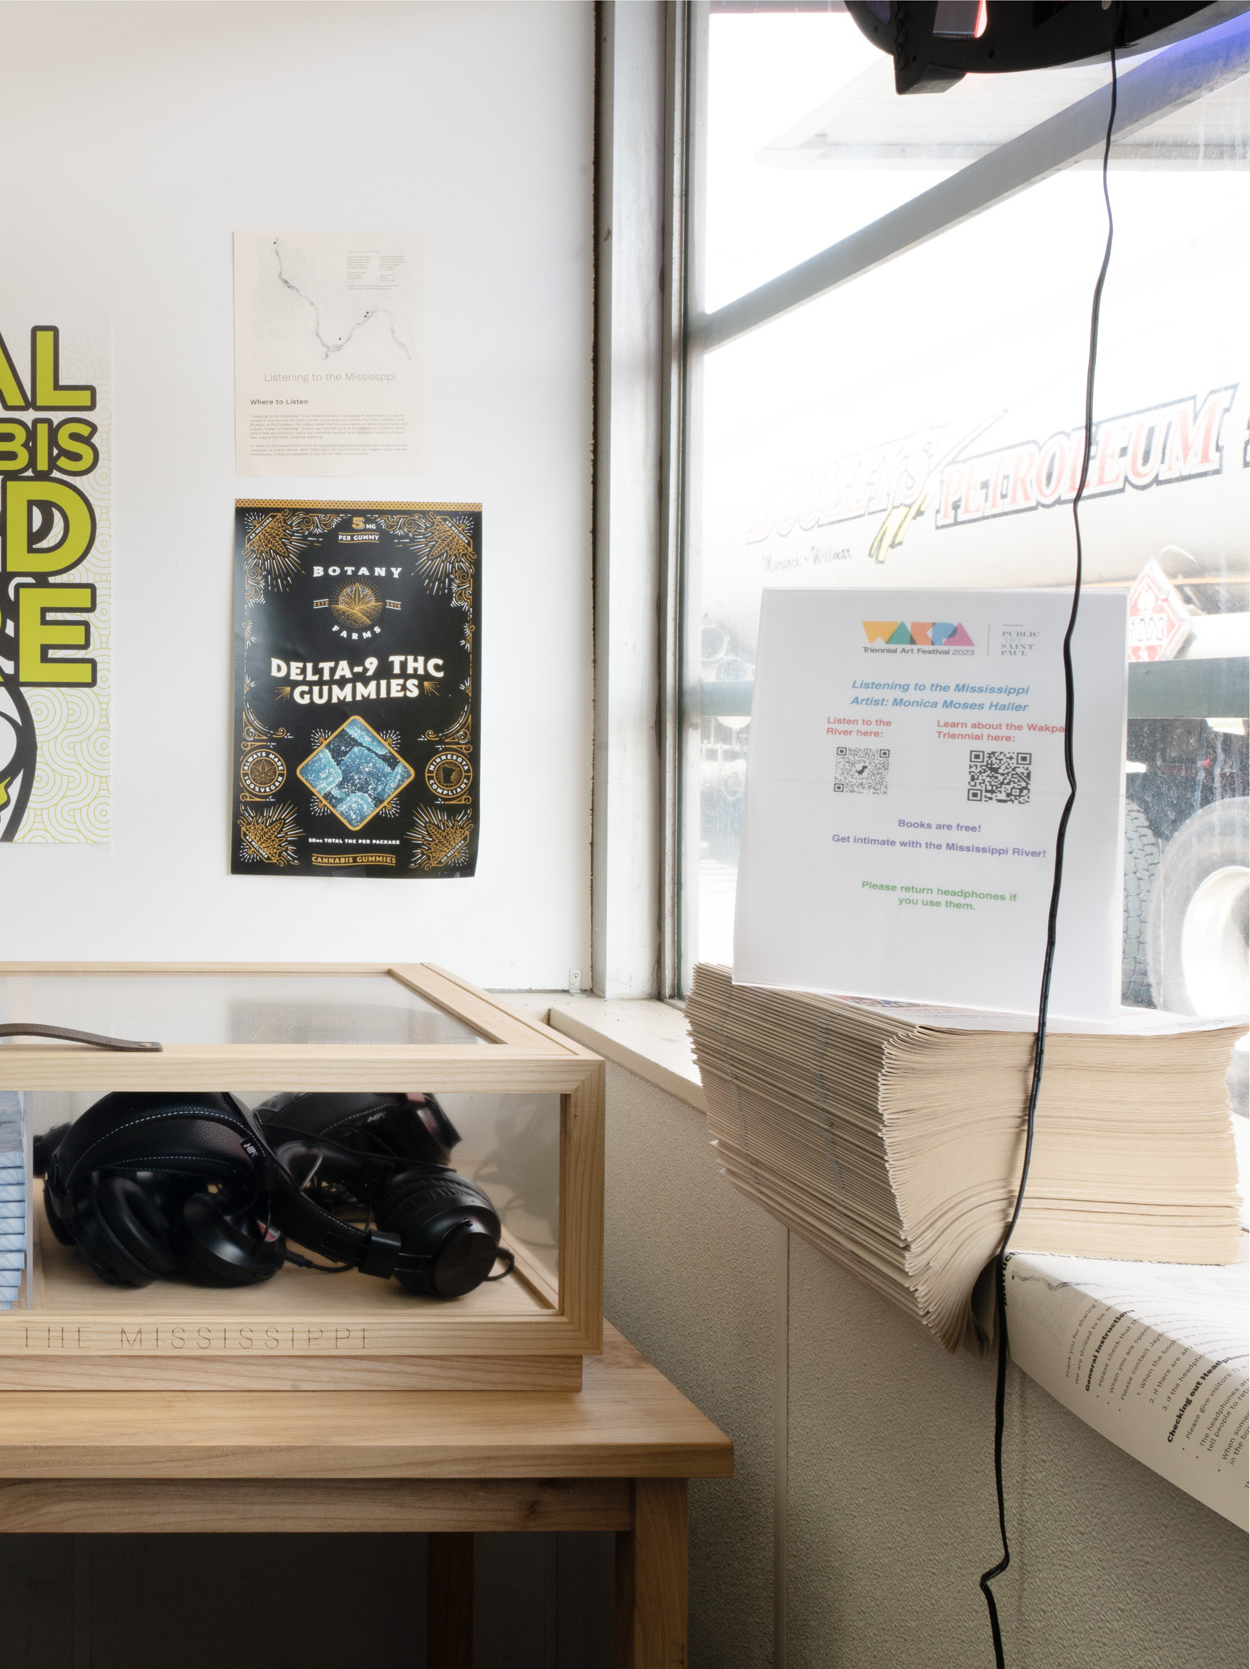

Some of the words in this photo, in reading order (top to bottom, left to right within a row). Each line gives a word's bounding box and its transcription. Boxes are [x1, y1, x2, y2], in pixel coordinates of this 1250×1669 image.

[264, 373, 309, 383] Listening
[312, 374, 322, 382] to
[325, 373, 342, 381] the
[935, 383, 1239, 530] PETROLEUM
[352, 517, 365, 529] 5
[313, 566, 402, 578] BOTANY
[331, 625, 382, 640] FARMS
[862, 647, 897, 655] Triennial
[900, 647, 914, 655] Art
[917, 648, 950, 656] Festival
[271, 657, 378, 681] DELTA-9
[389, 655, 444, 678] THC
[293, 679, 419, 704] GUMMIES
[852, 679, 910, 693] Listening
[914, 683, 927, 692] to
[930, 683, 950, 693] the
[954, 684, 1030, 696] Mississippi
[850, 696, 889, 707] Artist:
[892, 698, 939, 709] Monica
[942, 700, 985, 710] Moses
[988, 702, 1029, 712] Haller
[827, 716, 859, 726] Listen
[862, 718, 872, 726] to
[875, 718, 892, 727] the
[937, 720, 968, 729] Learn
[970, 721, 1003, 730] about
[1006, 722, 1024, 731] the
[1027, 723, 1066, 734] Wakpa
[826, 728, 853, 737] River
[856, 729, 884, 737] here:
[936, 731, 984, 741] Triennial
[987, 733, 1016, 742] here:
[244, 752, 266, 770] ALWAYS
[269, 753, 283, 771] MADE
[429, 754, 469, 771] MINNESOTA
[429, 779, 469, 795] COMPLIANT
[898, 819, 933, 829] Books
[935, 823, 952, 831] are
[956, 824, 981, 832] free!
[832, 834, 851, 843] Get
[853, 836, 896, 847] intimate
[899, 839, 922, 849] with
[925, 841, 943, 850] the
[946, 842, 1009, 857] Mississippi
[1012, 847, 1046, 858] River!
[862, 881, 897, 892] Please
[900, 884, 933, 894] return
[936, 887, 1006, 901] headphones
[1009, 893, 1017, 902] if
[898, 897, 919, 907] you
[922, 899, 942, 907] use
[945, 900, 976, 911] them.
[17, 1326, 93, 1349] THE
[120, 1326, 367, 1349] MISSISSIPPI
[1085, 1354, 1098, 1392] General
[1167, 1397, 1193, 1443] Checking
[1190, 1381, 1203, 1397] out
